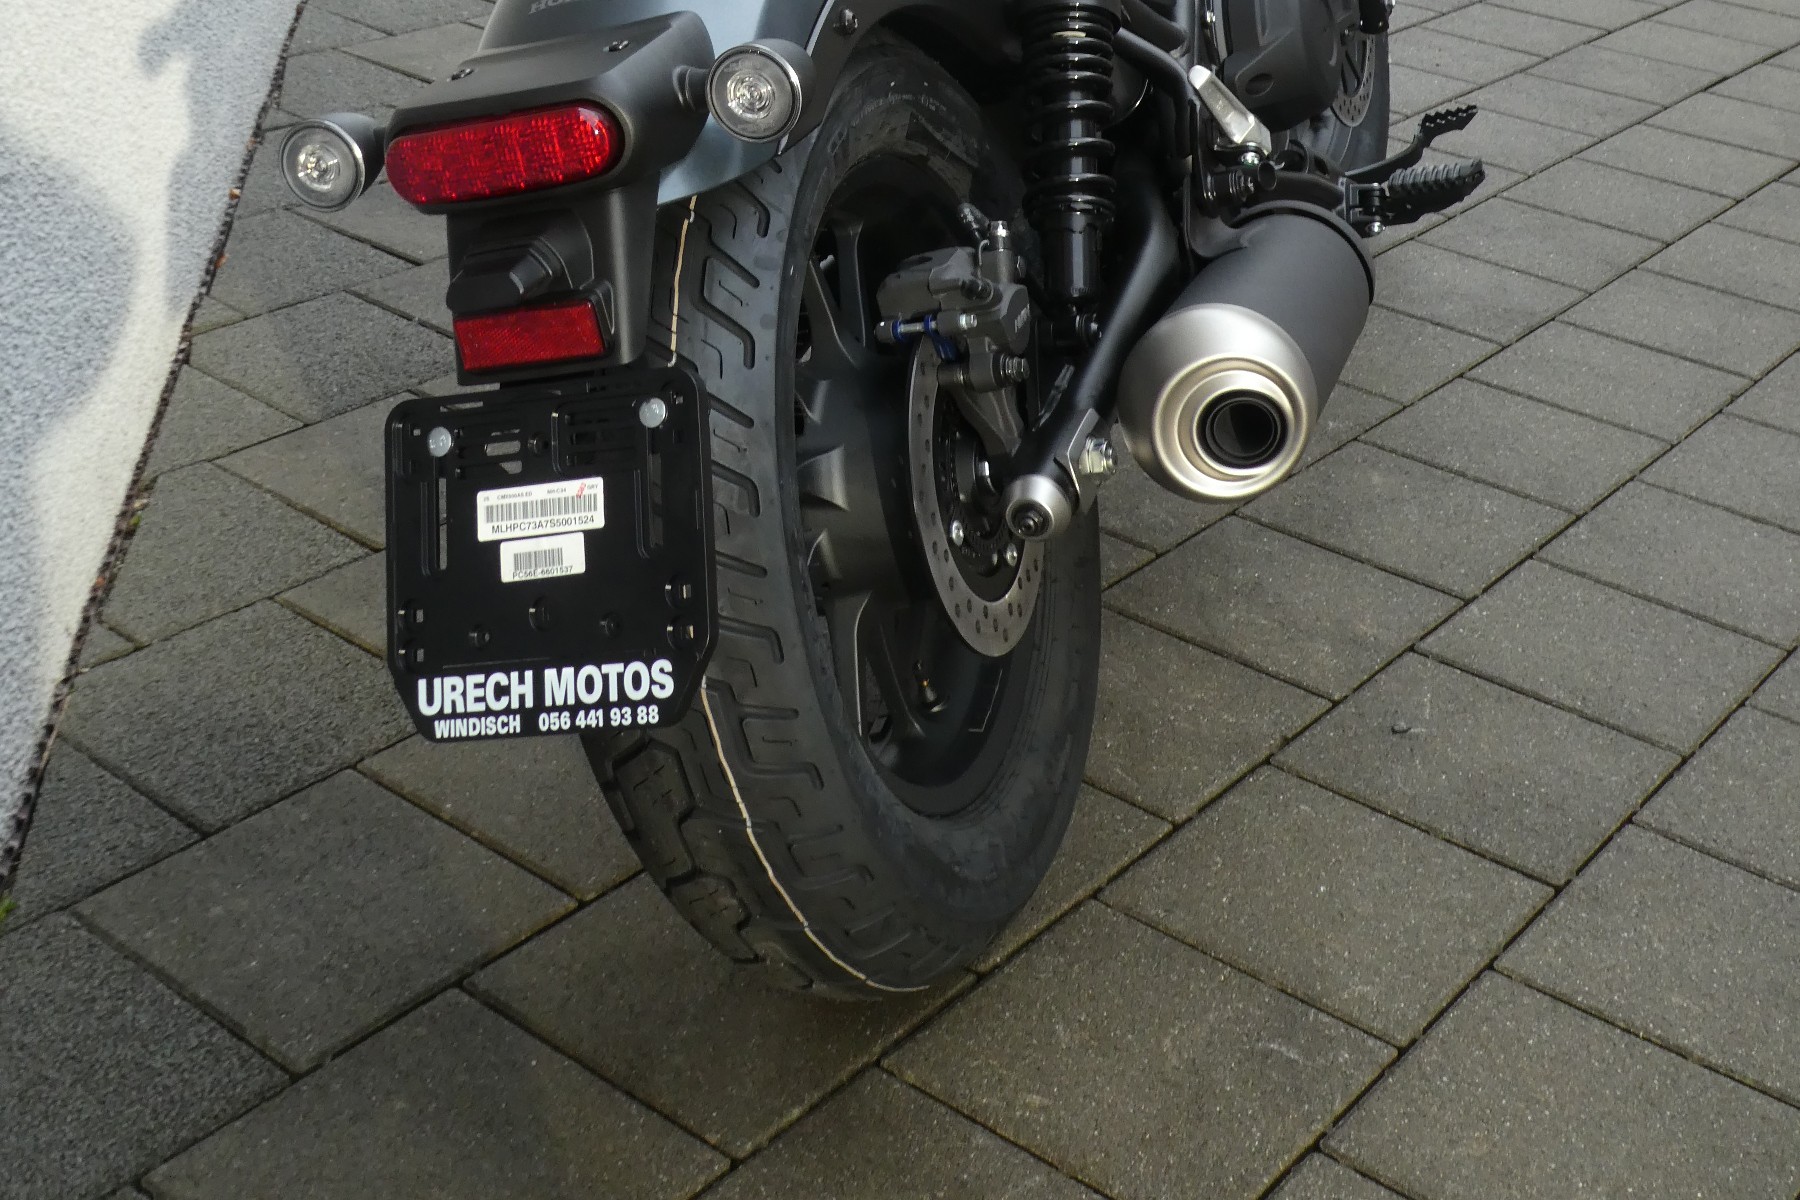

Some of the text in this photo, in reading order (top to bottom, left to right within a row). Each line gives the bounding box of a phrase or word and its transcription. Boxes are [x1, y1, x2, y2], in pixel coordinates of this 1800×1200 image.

[491, 515, 595, 535] MLHPC73A7S5001524
[417, 658, 675, 716] URECH MOTOS
[434, 704, 660, 739] WINDISCH 056 441 93 88
